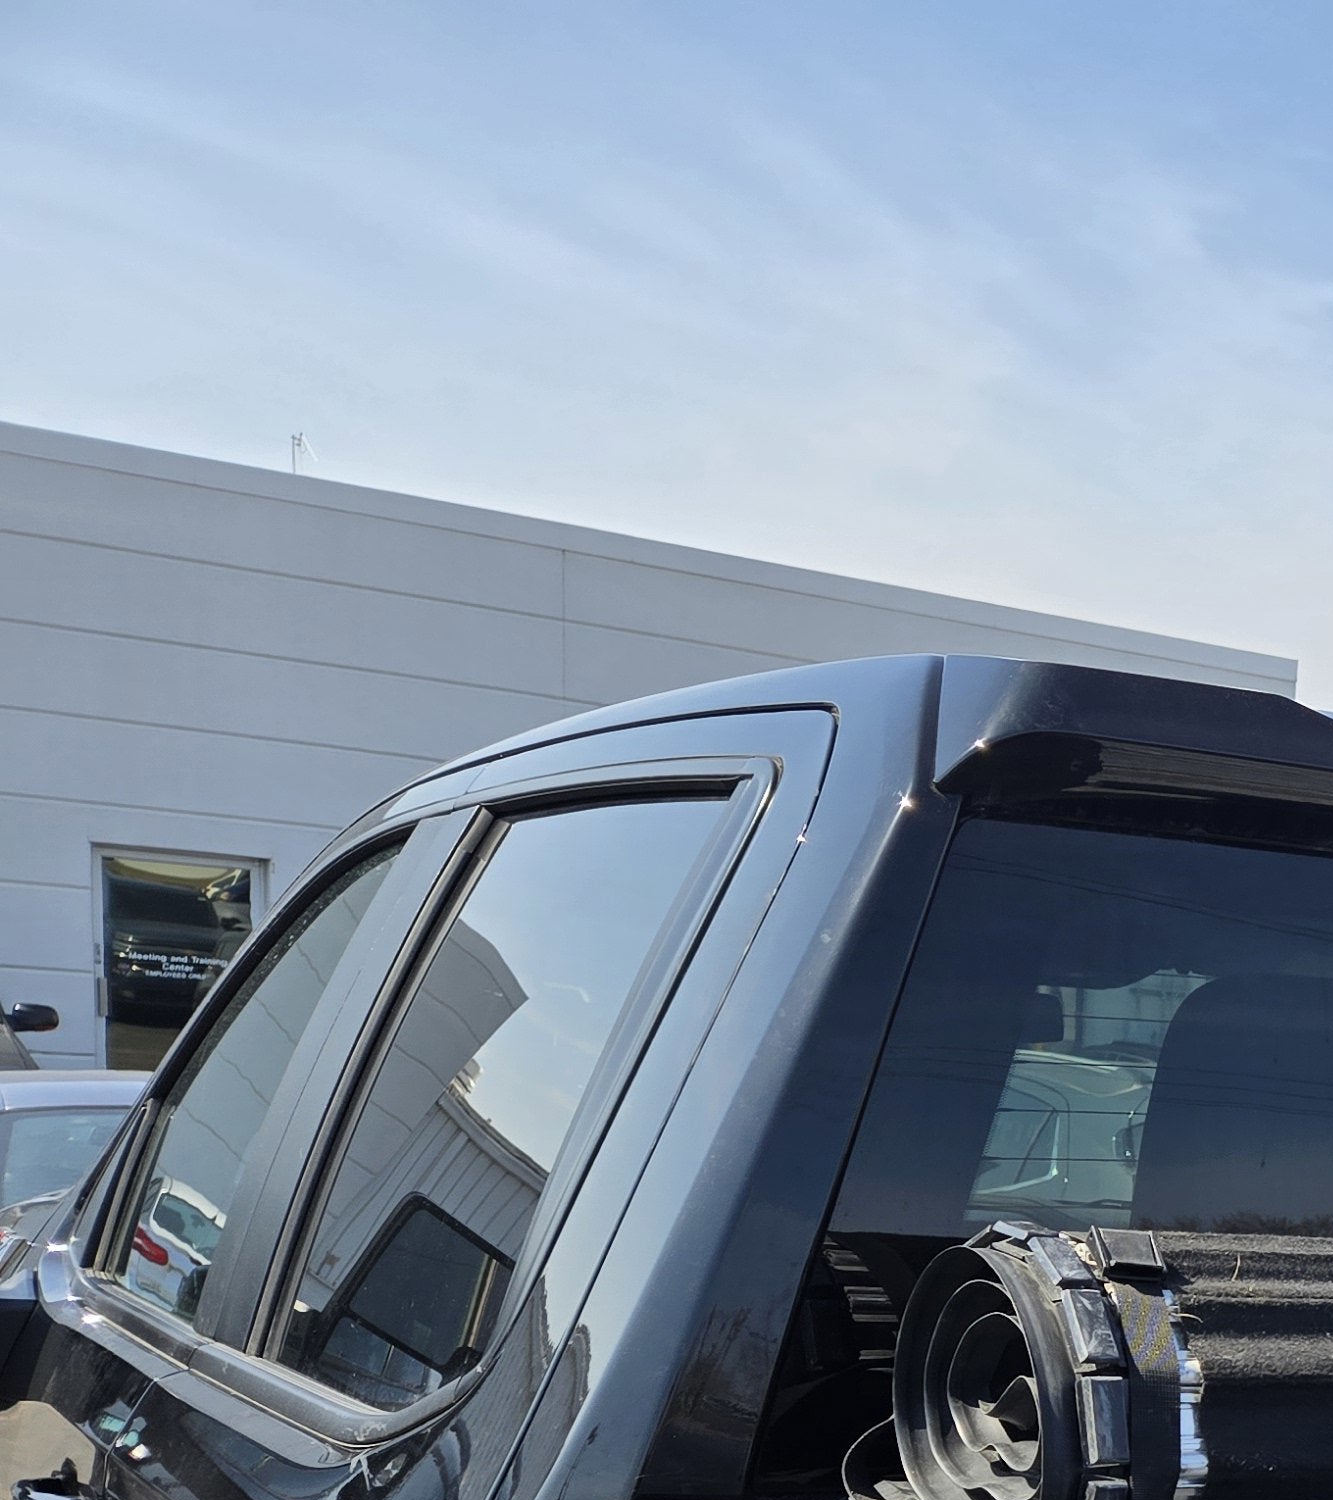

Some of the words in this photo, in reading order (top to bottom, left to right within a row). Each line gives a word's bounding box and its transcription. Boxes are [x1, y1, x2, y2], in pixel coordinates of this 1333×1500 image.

[128, 951, 168, 963] Meeting
[170, 955, 188, 964] and
[192, 955, 229, 968] Training
[161, 962, 194, 973] Center
